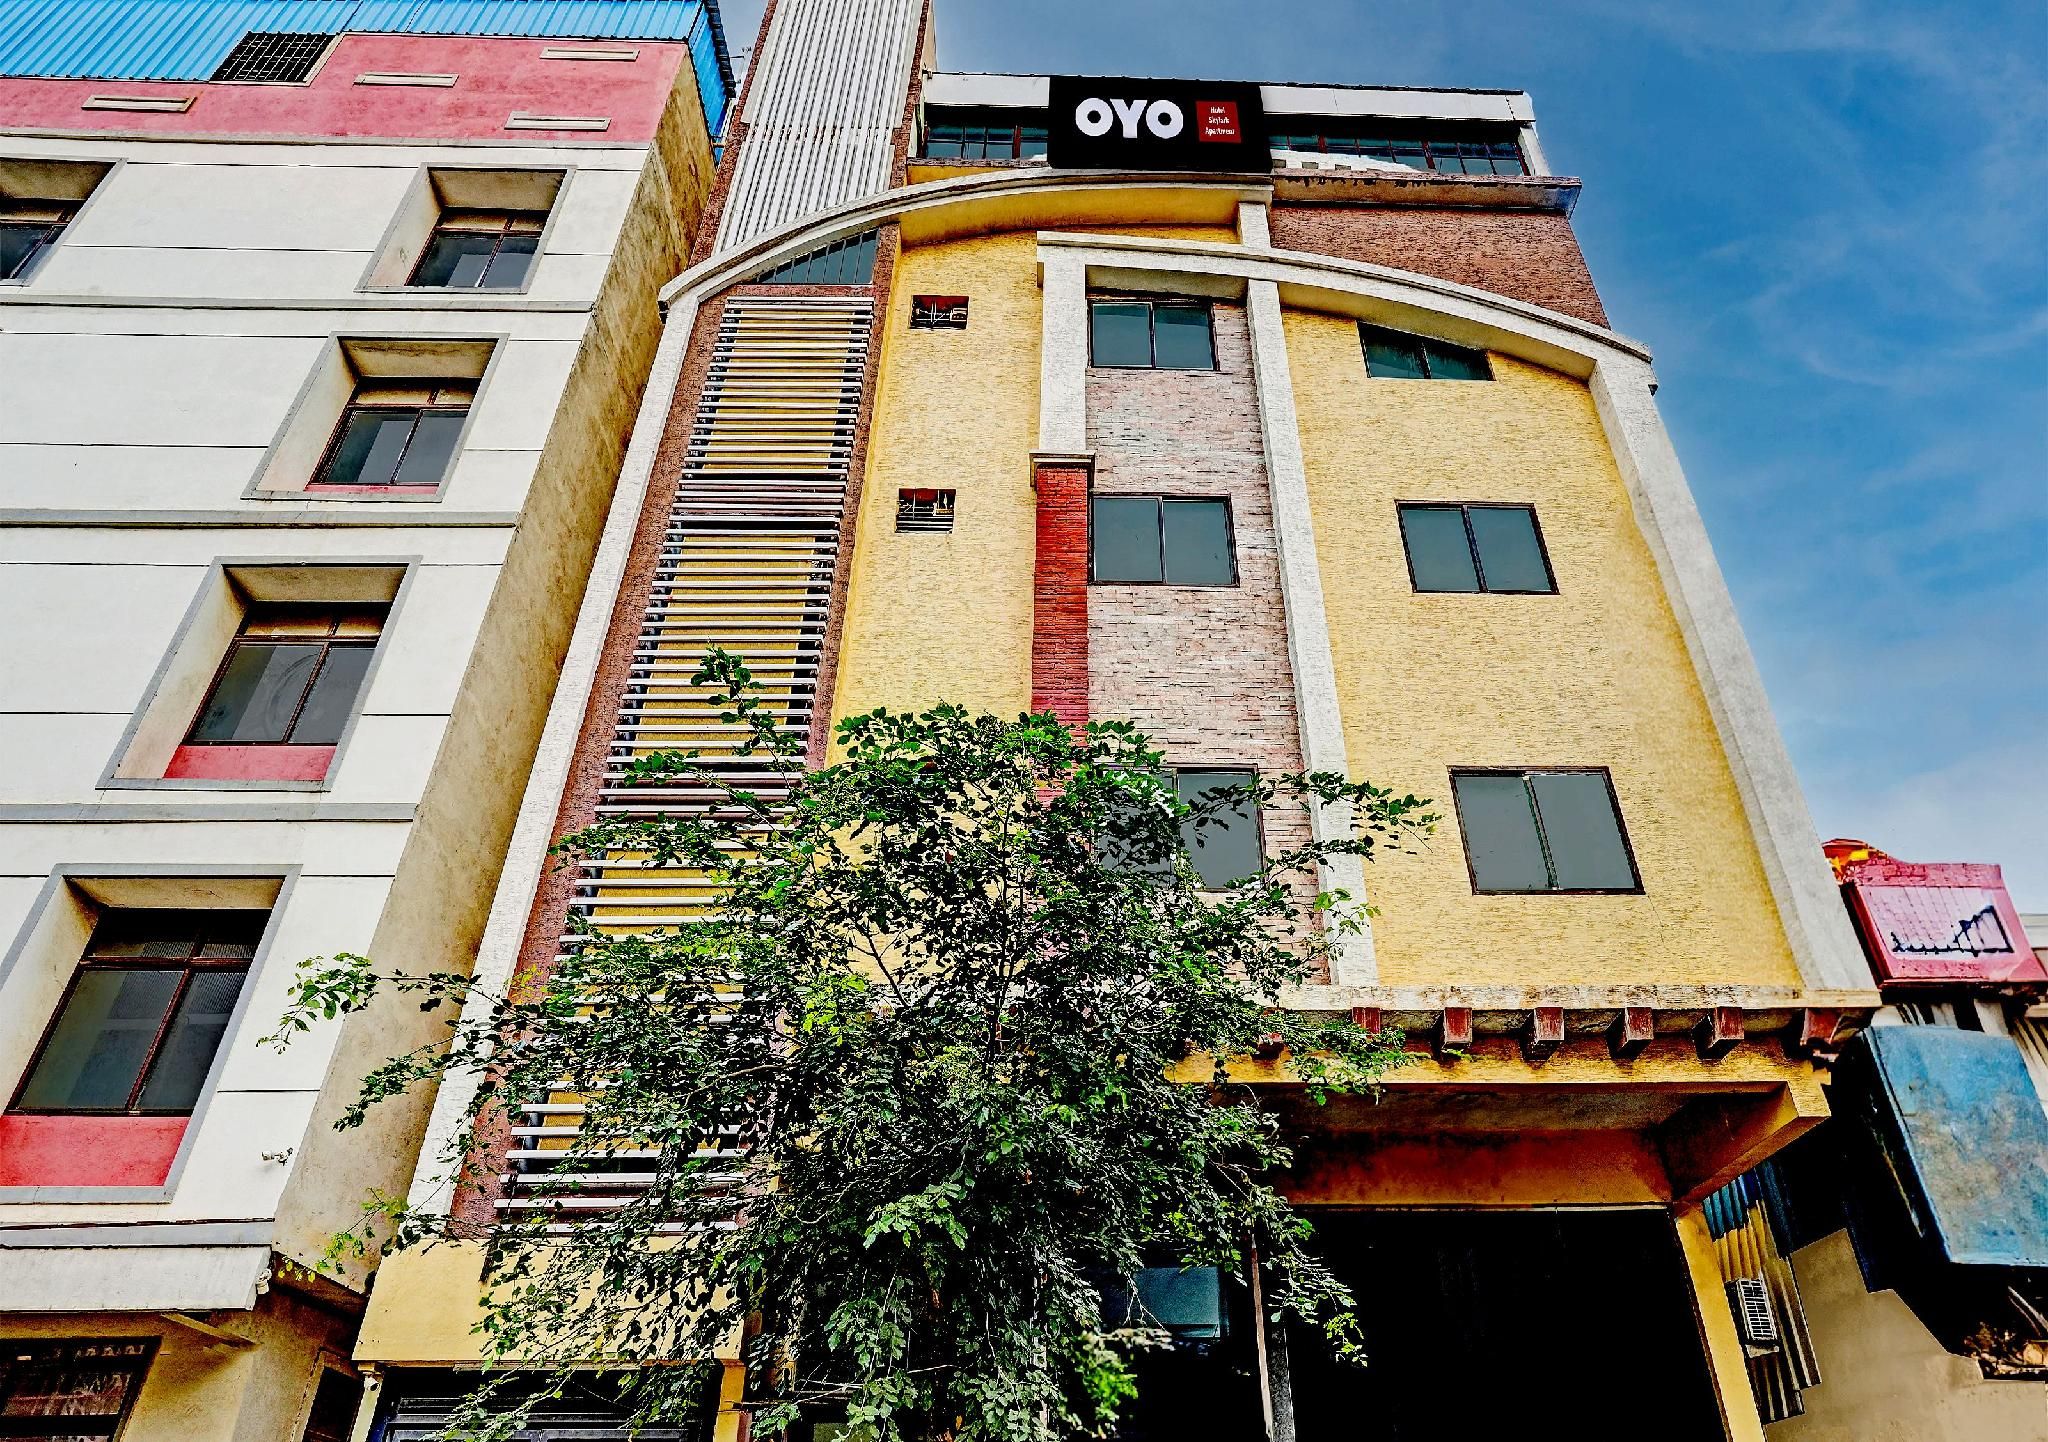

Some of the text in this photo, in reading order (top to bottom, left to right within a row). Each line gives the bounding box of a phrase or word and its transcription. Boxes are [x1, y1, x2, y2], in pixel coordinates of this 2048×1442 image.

[1210, 106, 1226, 114] Hotel
[1075, 97, 1184, 139] OYO
[1208, 115, 1230, 126] Skylark
